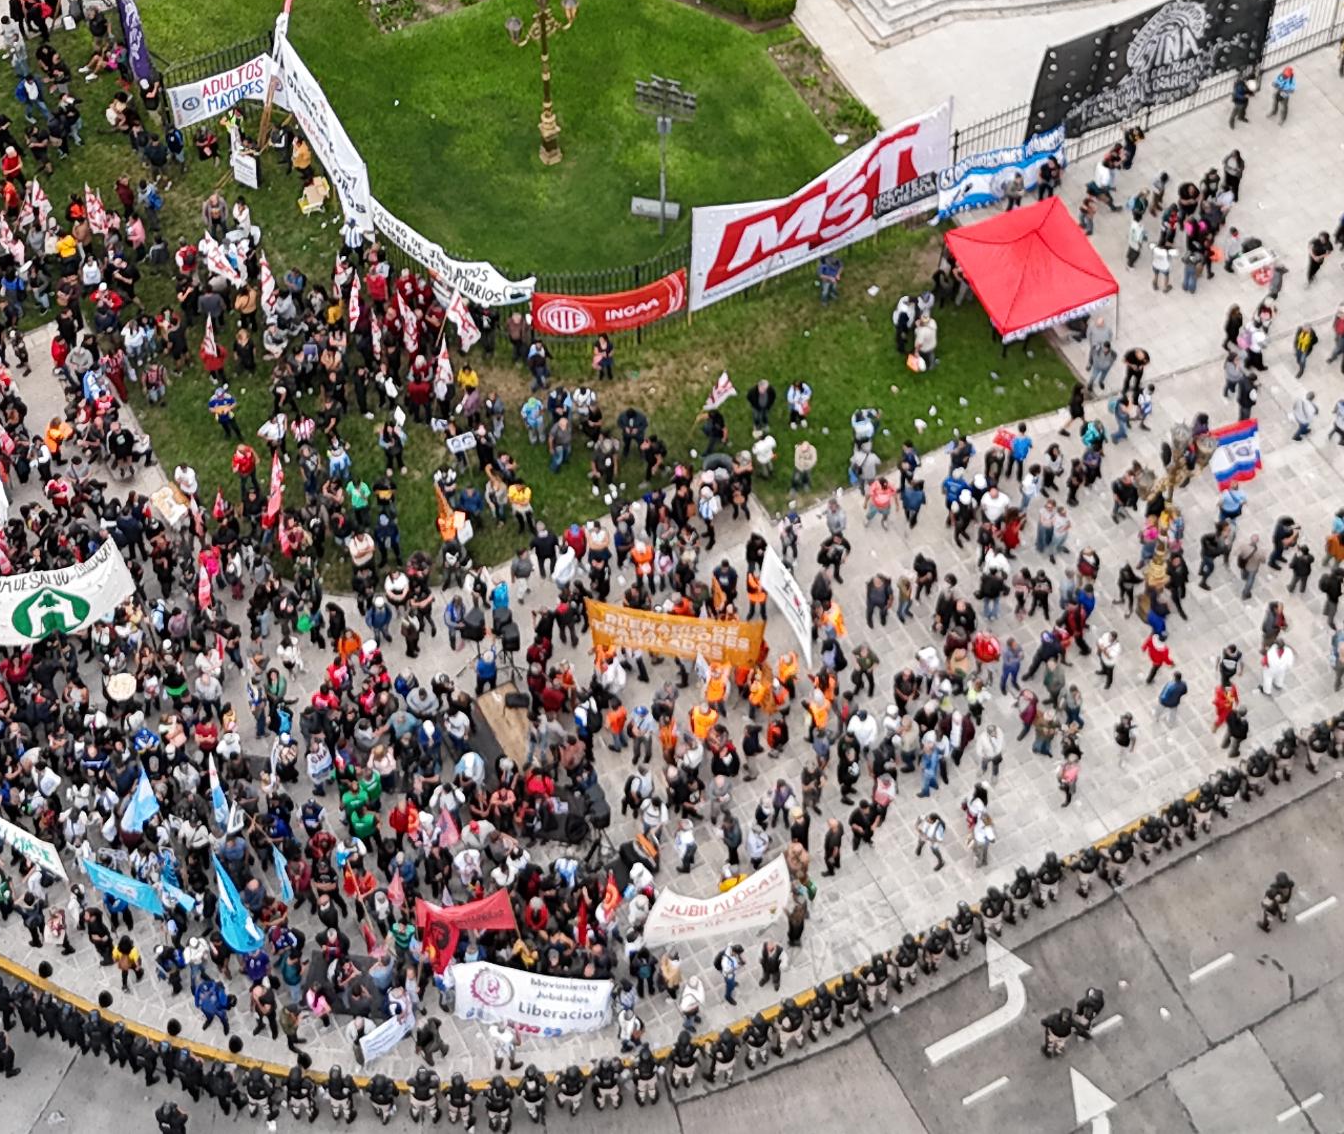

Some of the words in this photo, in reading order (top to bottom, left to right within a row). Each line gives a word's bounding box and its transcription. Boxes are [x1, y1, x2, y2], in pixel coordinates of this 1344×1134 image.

[202, 58, 263, 99] ADULTOS
[207, 78, 264, 113] MAYORES
[728, 132, 914, 272] MST
[14, 577, 27, 590] DE
[29, 571, 70, 588] SALUD
[529, 977, 599, 992] Movimiento
[536, 991, 590, 1004] Jubilados
